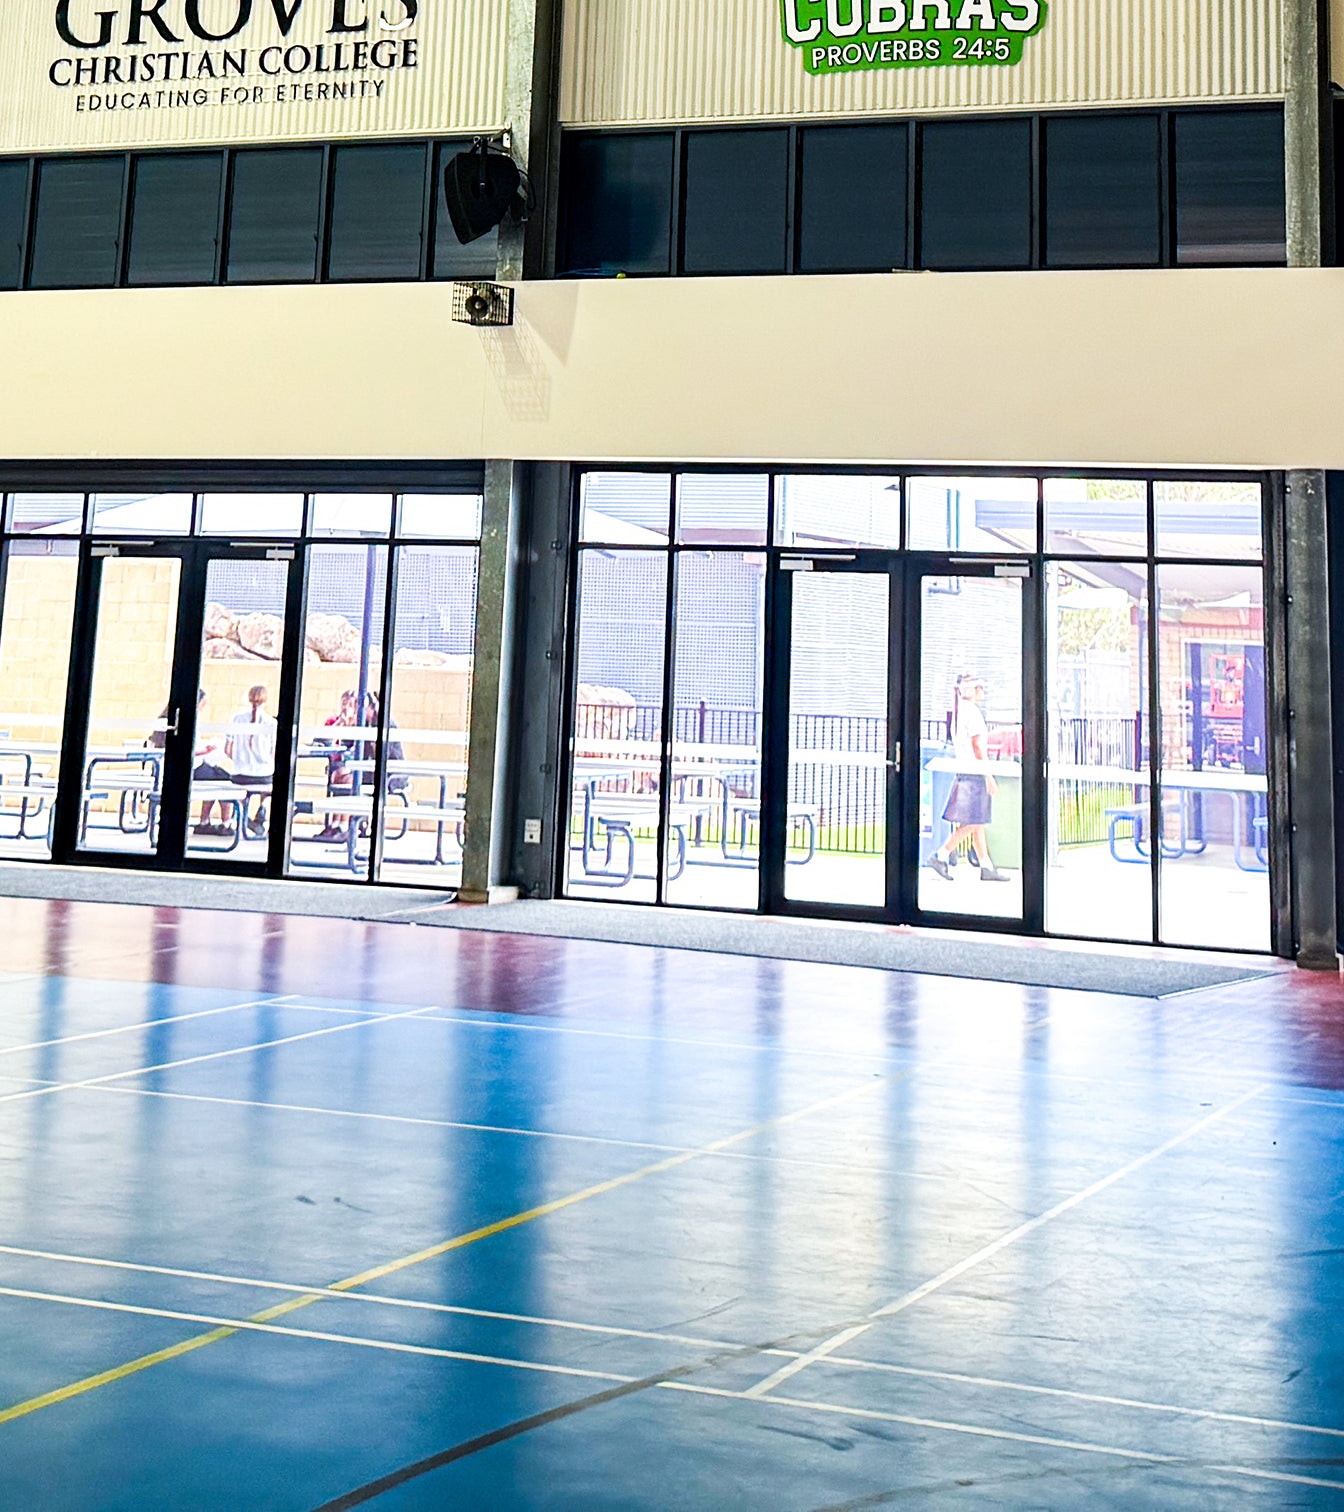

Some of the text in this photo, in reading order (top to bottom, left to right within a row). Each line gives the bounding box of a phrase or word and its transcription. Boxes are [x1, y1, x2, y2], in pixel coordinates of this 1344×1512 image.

[49, 39, 419, 87] CHRISTIAN COLLEGE
[812, 37, 1010, 68] PROVERBS 24:5
[76, 80, 385, 112] EDUCATING FOR ETERNITY
